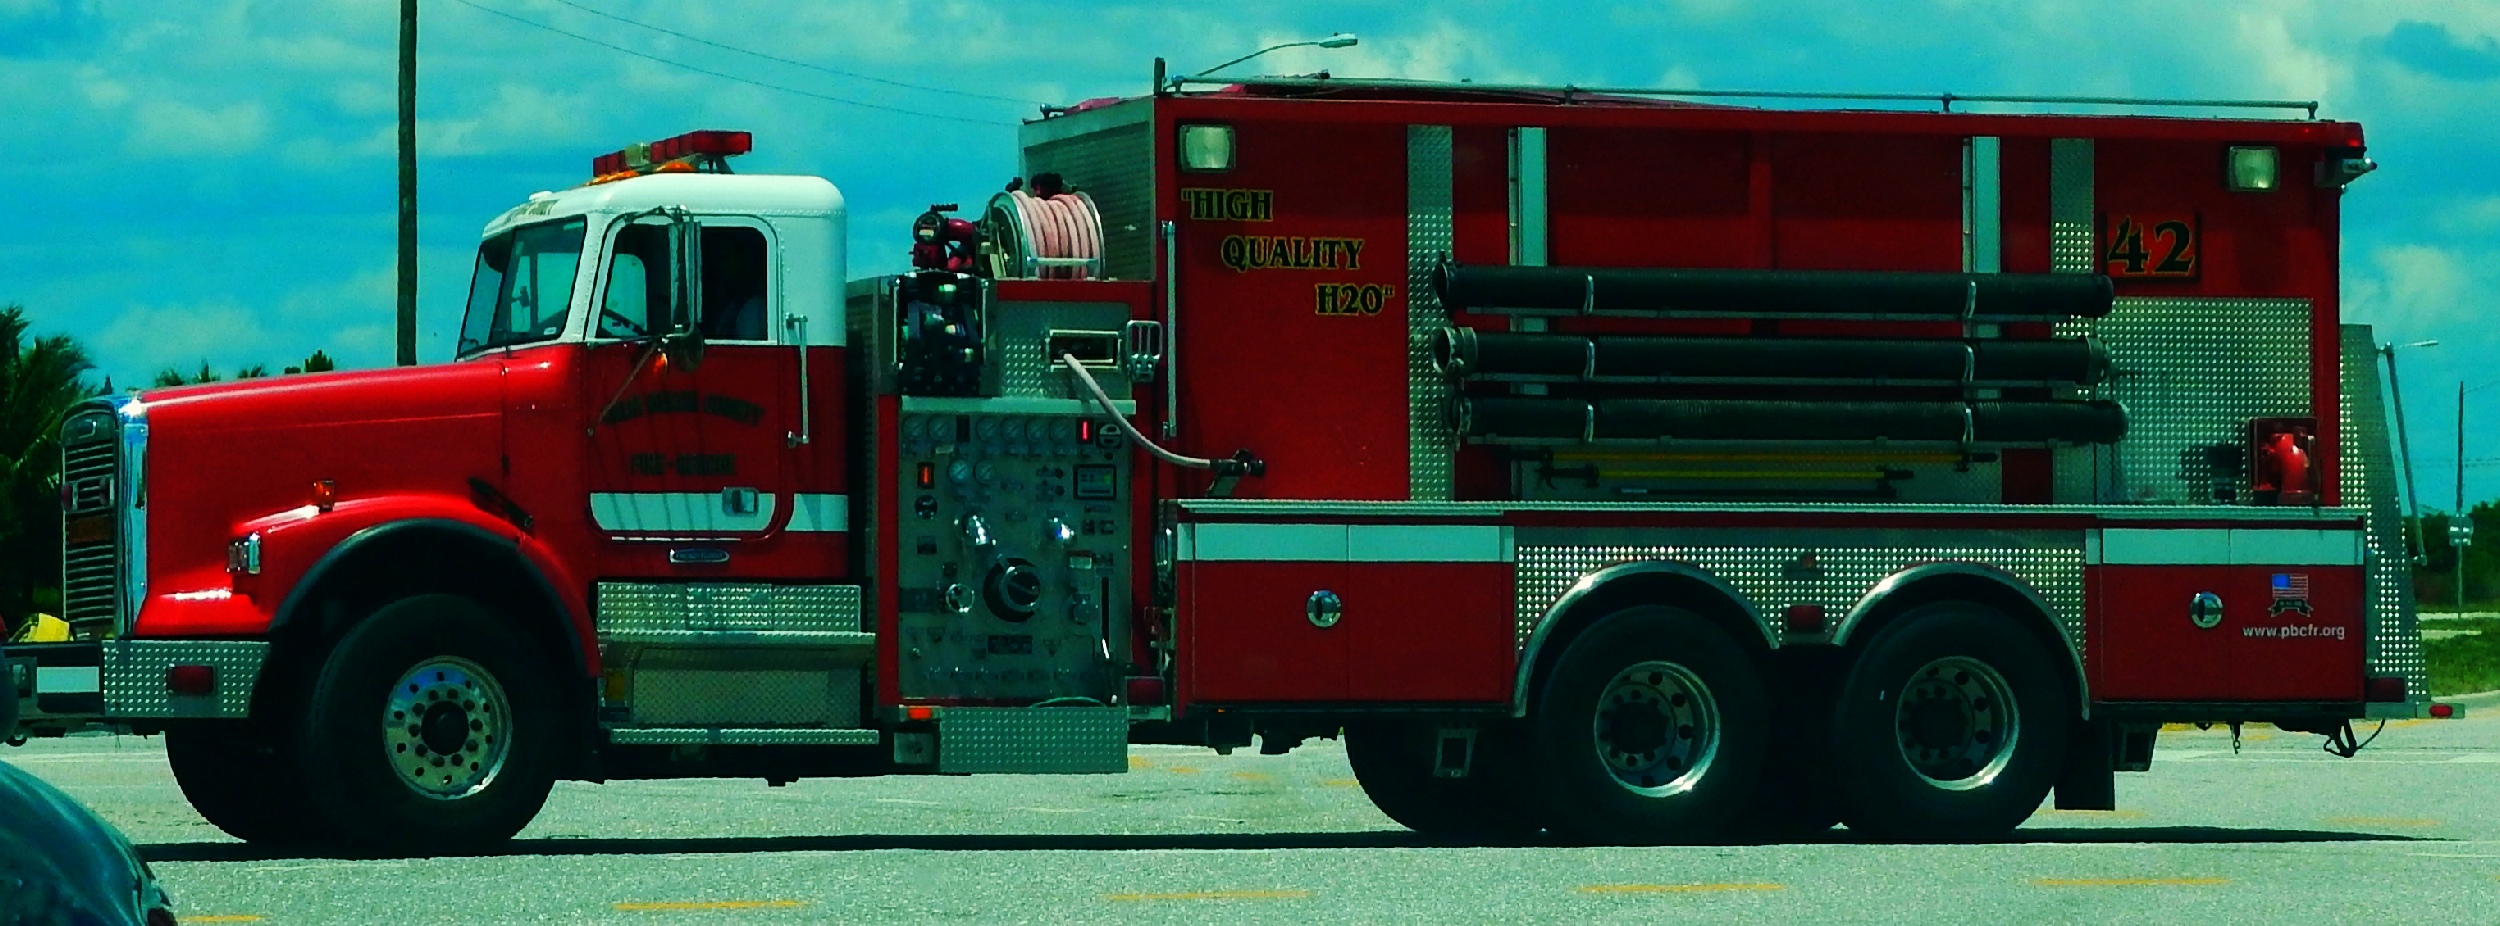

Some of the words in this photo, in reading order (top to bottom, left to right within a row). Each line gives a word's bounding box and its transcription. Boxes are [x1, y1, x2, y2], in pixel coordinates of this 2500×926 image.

[1221, 235, 1365, 273] QUALITY
[2107, 215, 2196, 275] 42
[2243, 624, 2345, 640] www.pbcfr.org
